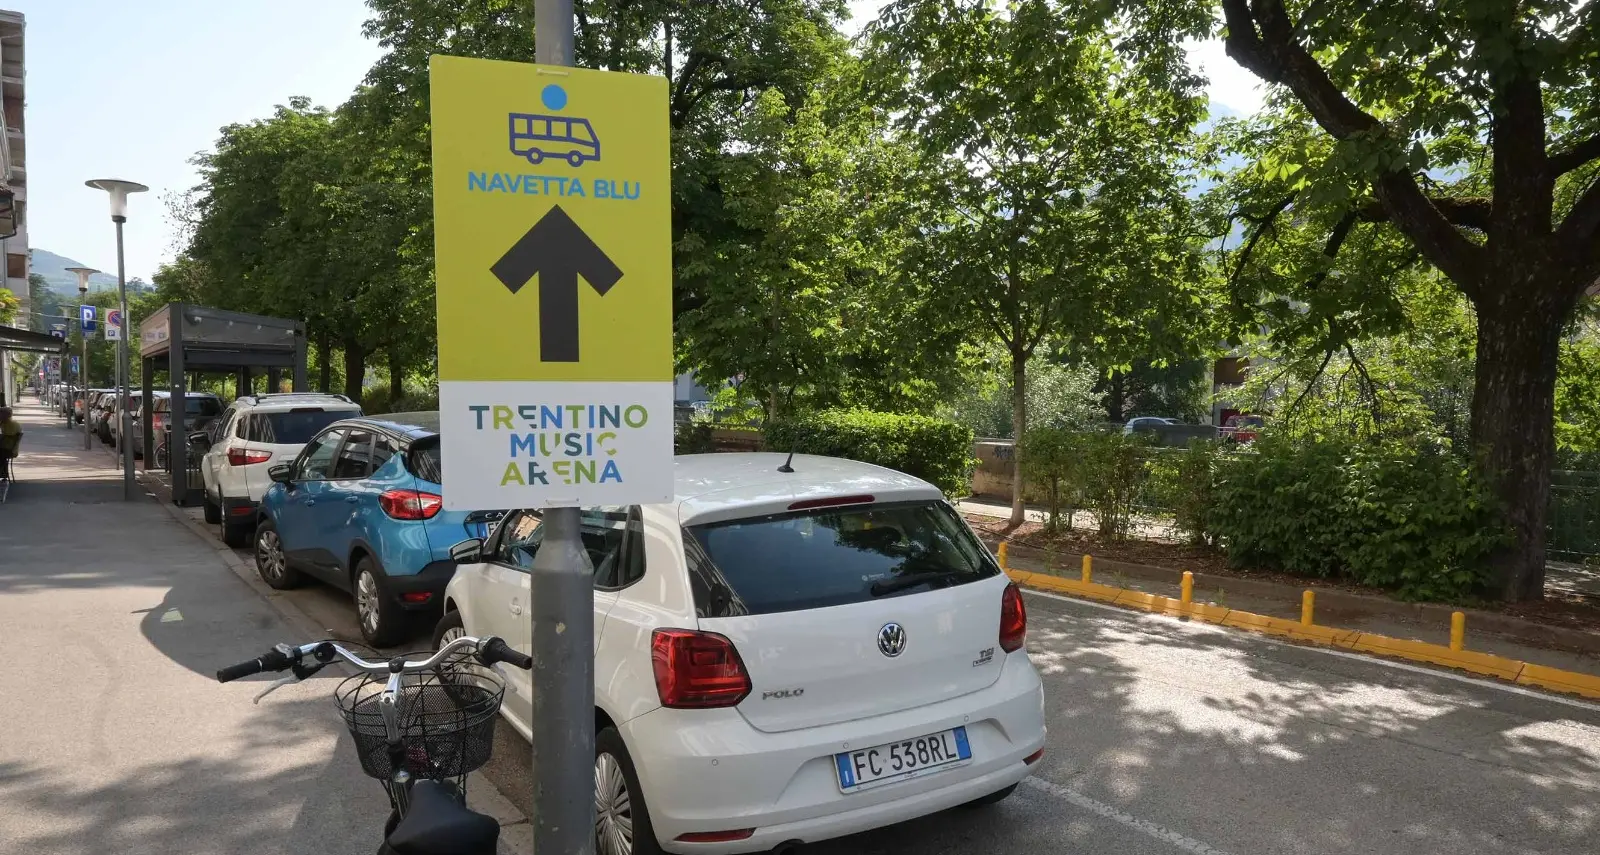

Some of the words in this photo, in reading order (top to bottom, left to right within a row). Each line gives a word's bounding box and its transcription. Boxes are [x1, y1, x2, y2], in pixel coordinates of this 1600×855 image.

[468, 171, 586, 197] NAVETTA
[594, 179, 641, 200] BLU
[83, 308, 93, 327] P
[468, 405, 648, 430] TRENTINO
[510, 432, 618, 458] MUSIC
[500, 460, 623, 486] ARENA
[762, 687, 804, 700] POLO
[853, 749, 883, 781] FC
[890, 734, 957, 771] 538RL
